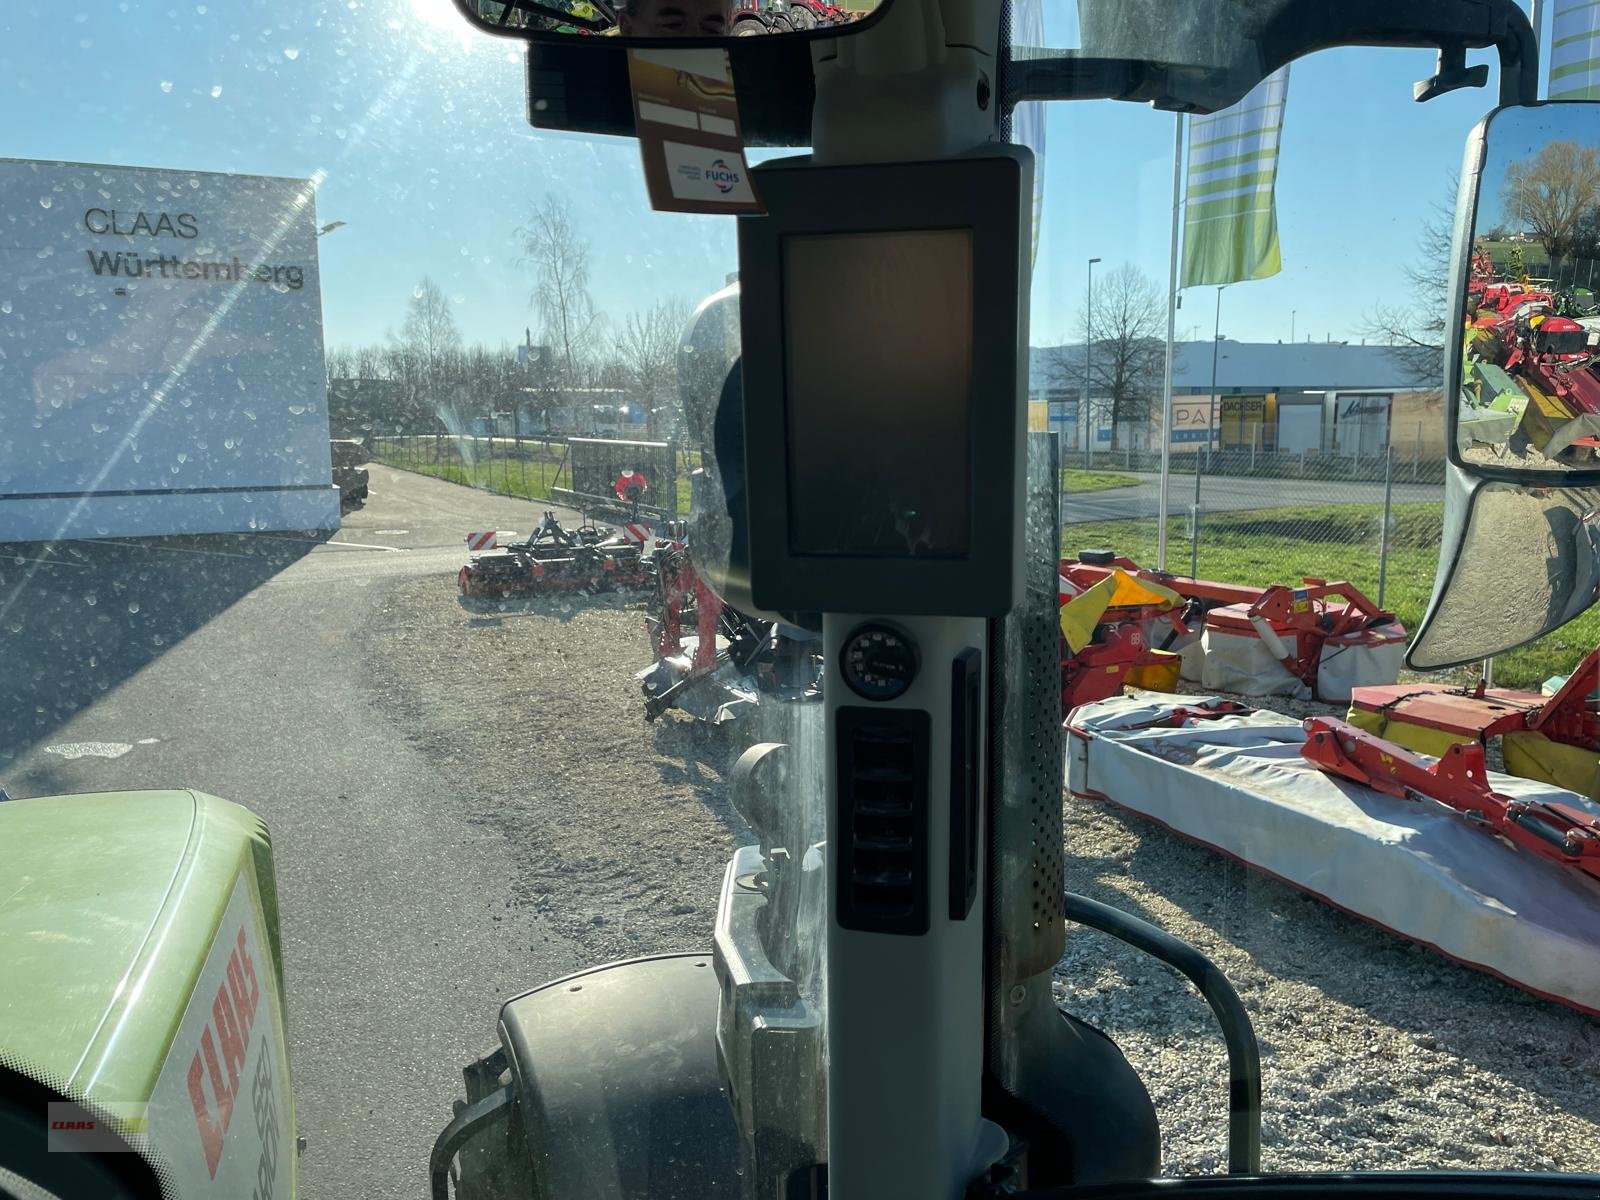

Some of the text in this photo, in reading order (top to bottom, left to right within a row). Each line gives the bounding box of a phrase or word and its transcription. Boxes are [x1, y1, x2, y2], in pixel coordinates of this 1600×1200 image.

[705, 170, 740, 183] FUCHS
[84, 208, 199, 239] CLAAS
[87, 250, 304, 290] Württemberg
[187, 923, 259, 1181] CLAAS
[252, 1087, 280, 1200] RION
